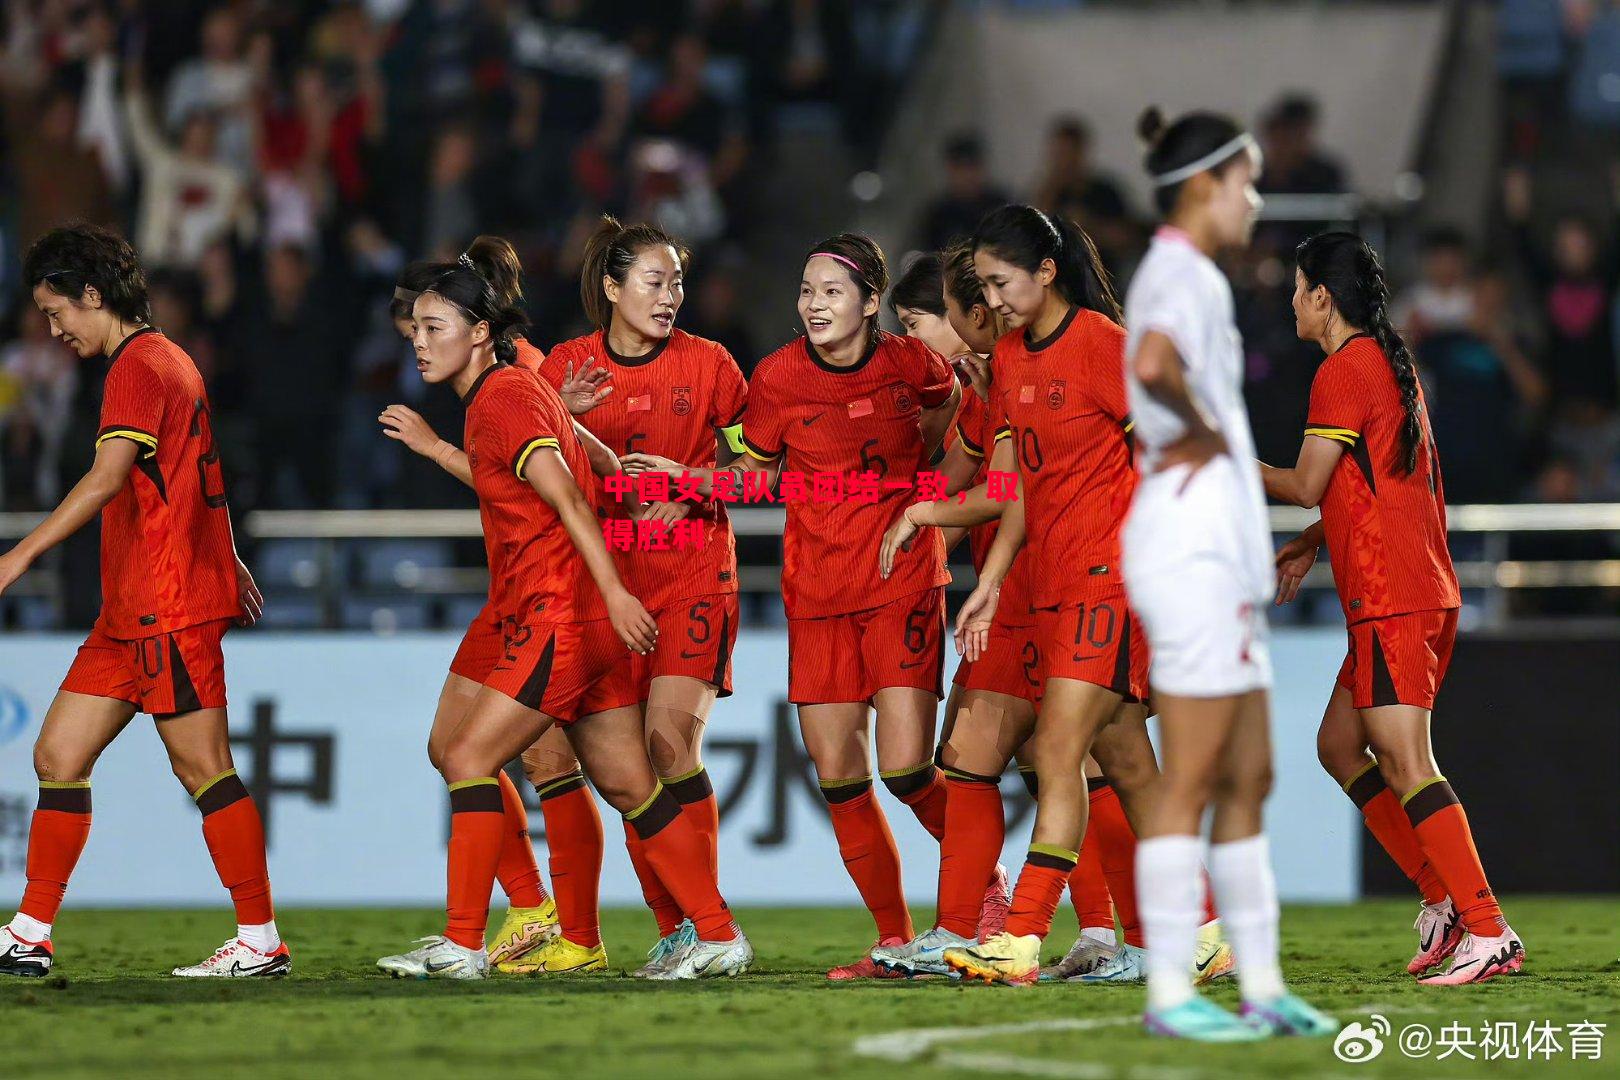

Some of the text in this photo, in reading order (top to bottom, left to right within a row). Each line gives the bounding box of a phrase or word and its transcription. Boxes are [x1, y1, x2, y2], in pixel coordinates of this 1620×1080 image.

[687, 601, 711, 644] 5
[903, 609, 927, 655] 6
[1074, 602, 1116, 648] 10
